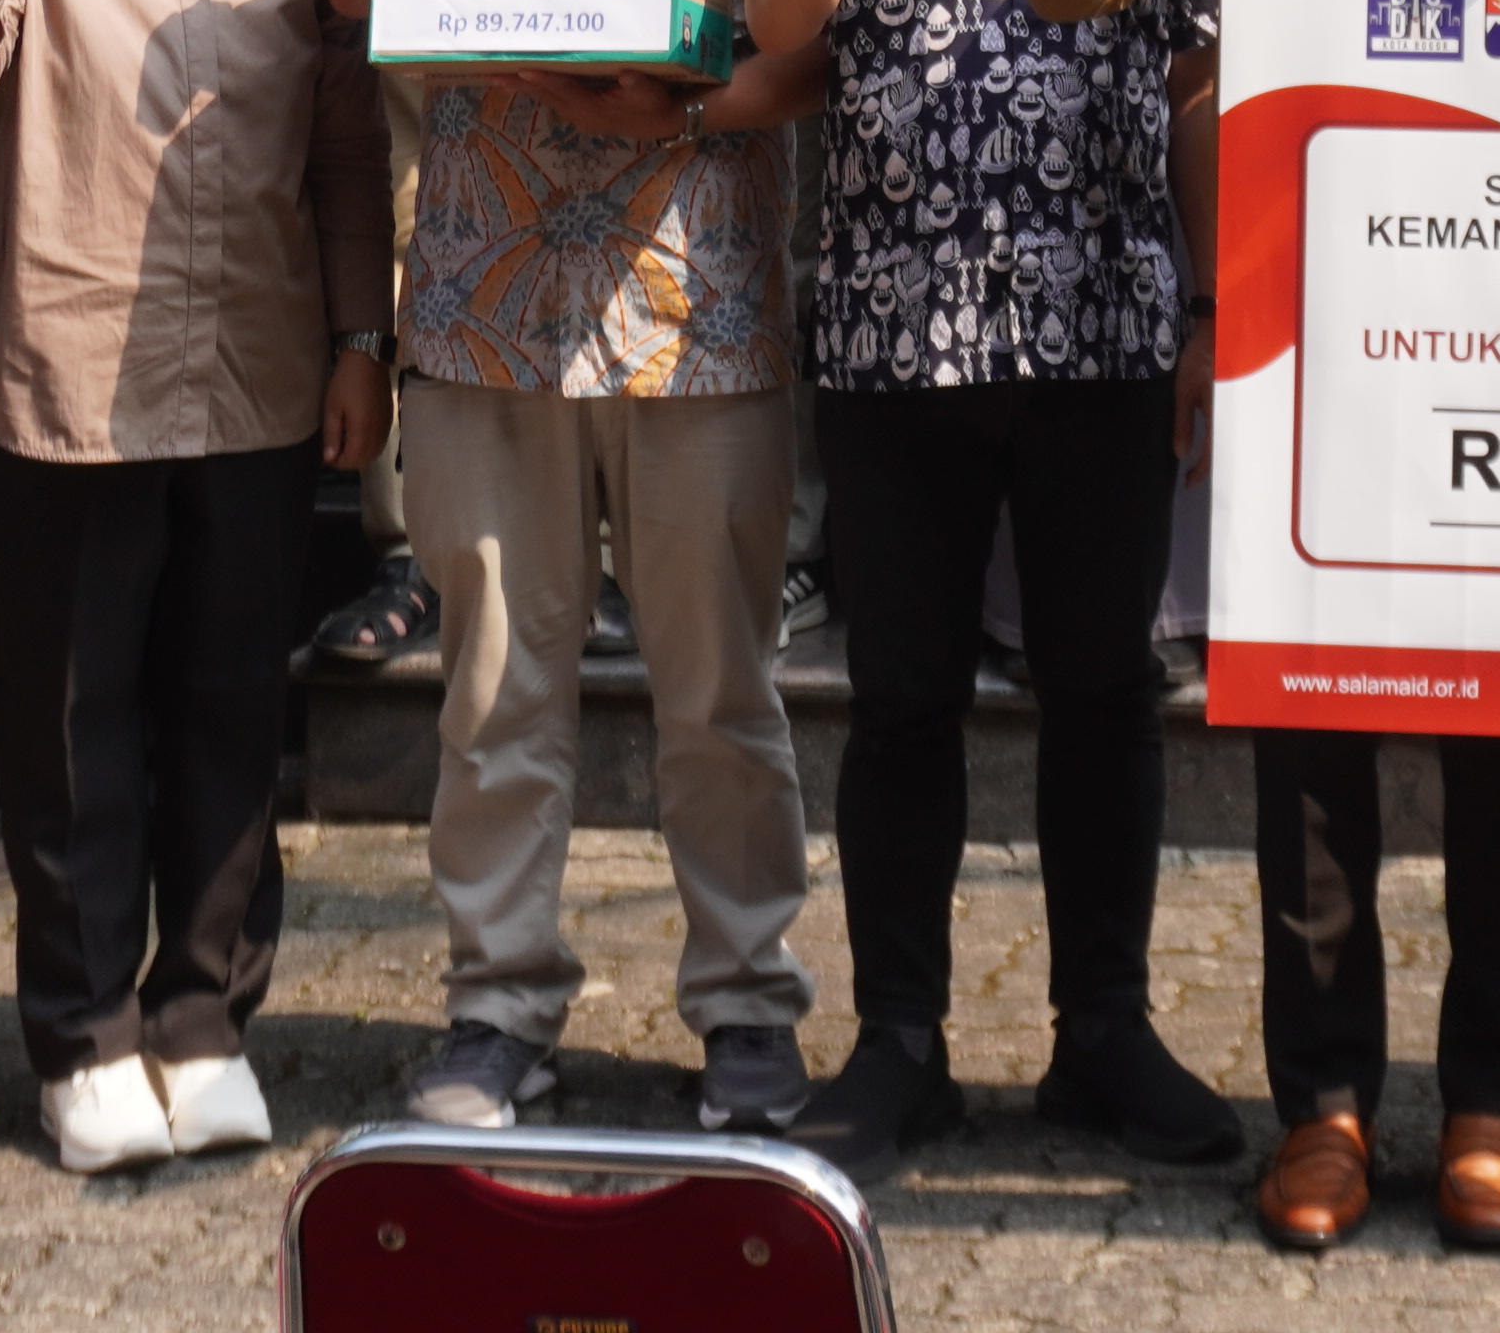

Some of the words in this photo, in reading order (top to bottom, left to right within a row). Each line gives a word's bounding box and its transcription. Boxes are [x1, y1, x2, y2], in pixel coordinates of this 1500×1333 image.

[438, 13, 468, 37] Rp
[475, 12, 605, 32] 89.747.100
[1281, 673, 1479, 699] www.salamaid.or.id
